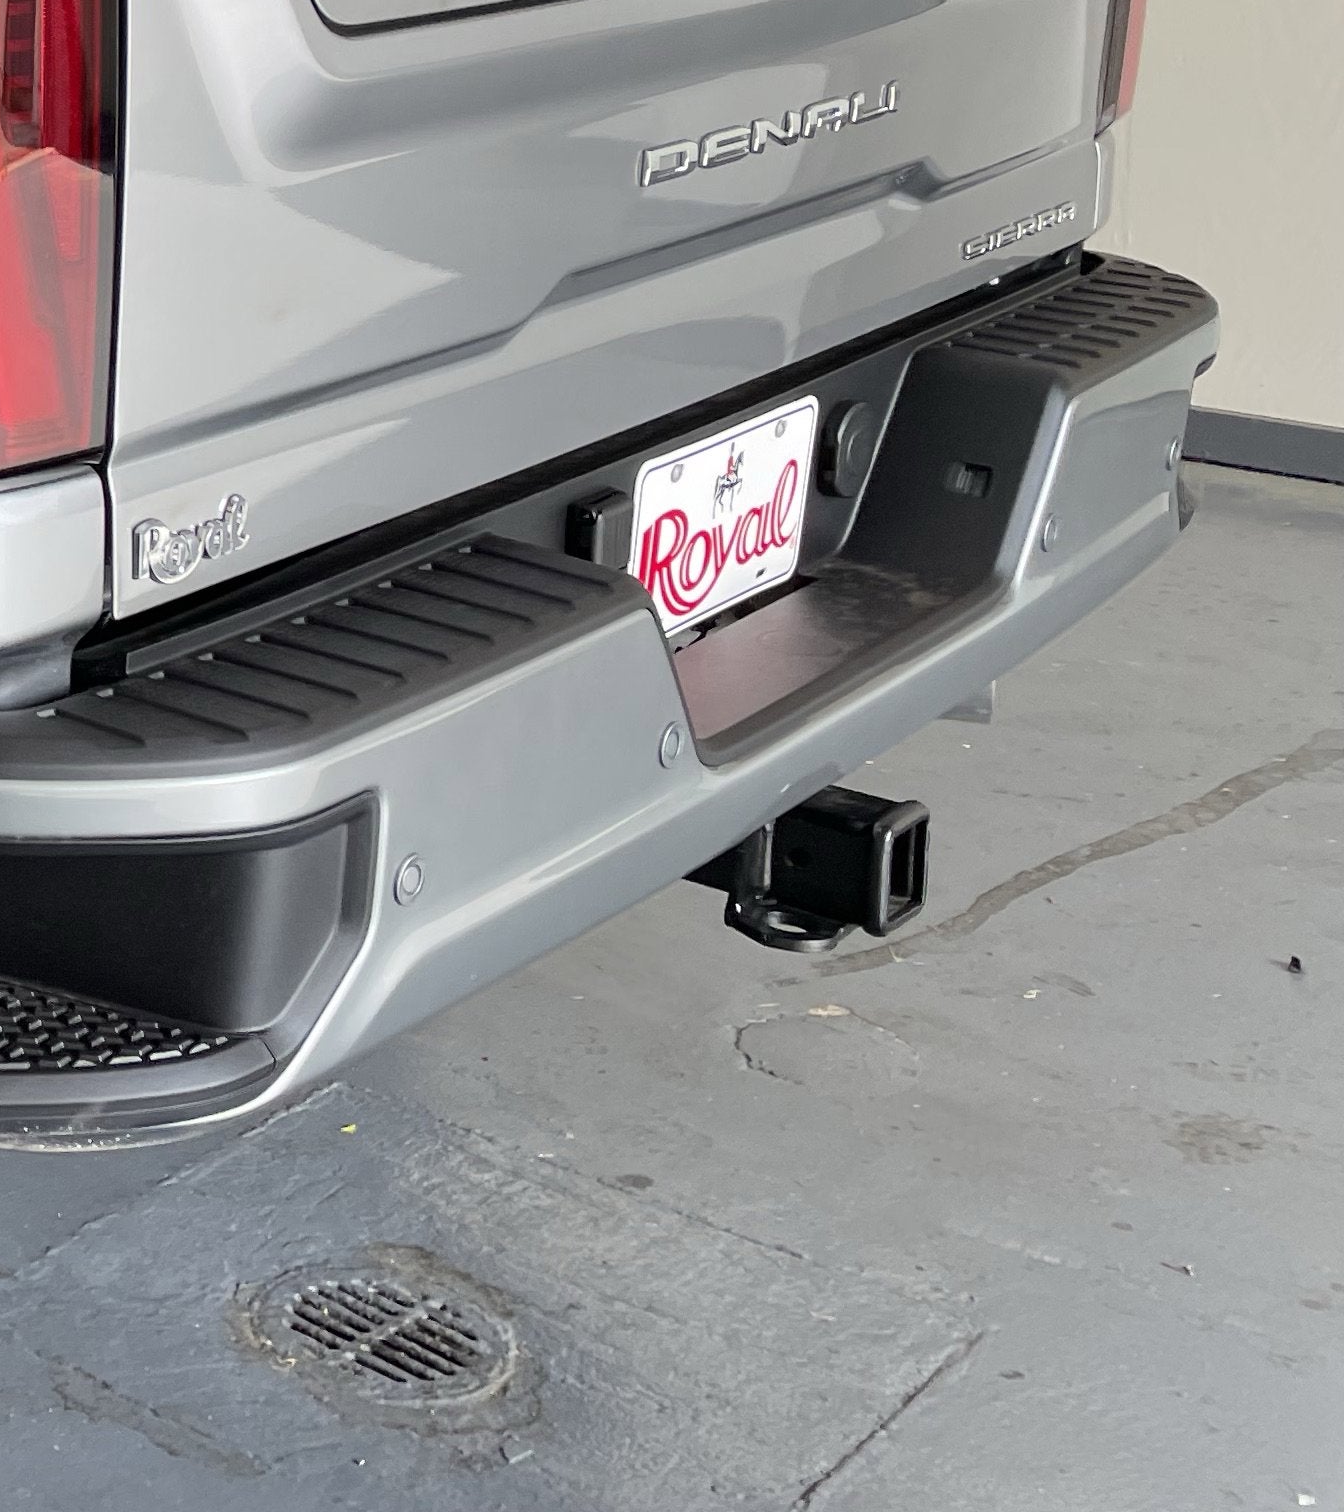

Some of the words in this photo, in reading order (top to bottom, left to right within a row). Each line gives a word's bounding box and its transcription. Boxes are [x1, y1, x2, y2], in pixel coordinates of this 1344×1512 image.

[638, 80, 900, 187] DENALI
[962, 200, 1076, 261] SIERRA
[638, 459, 798, 616] Royal
